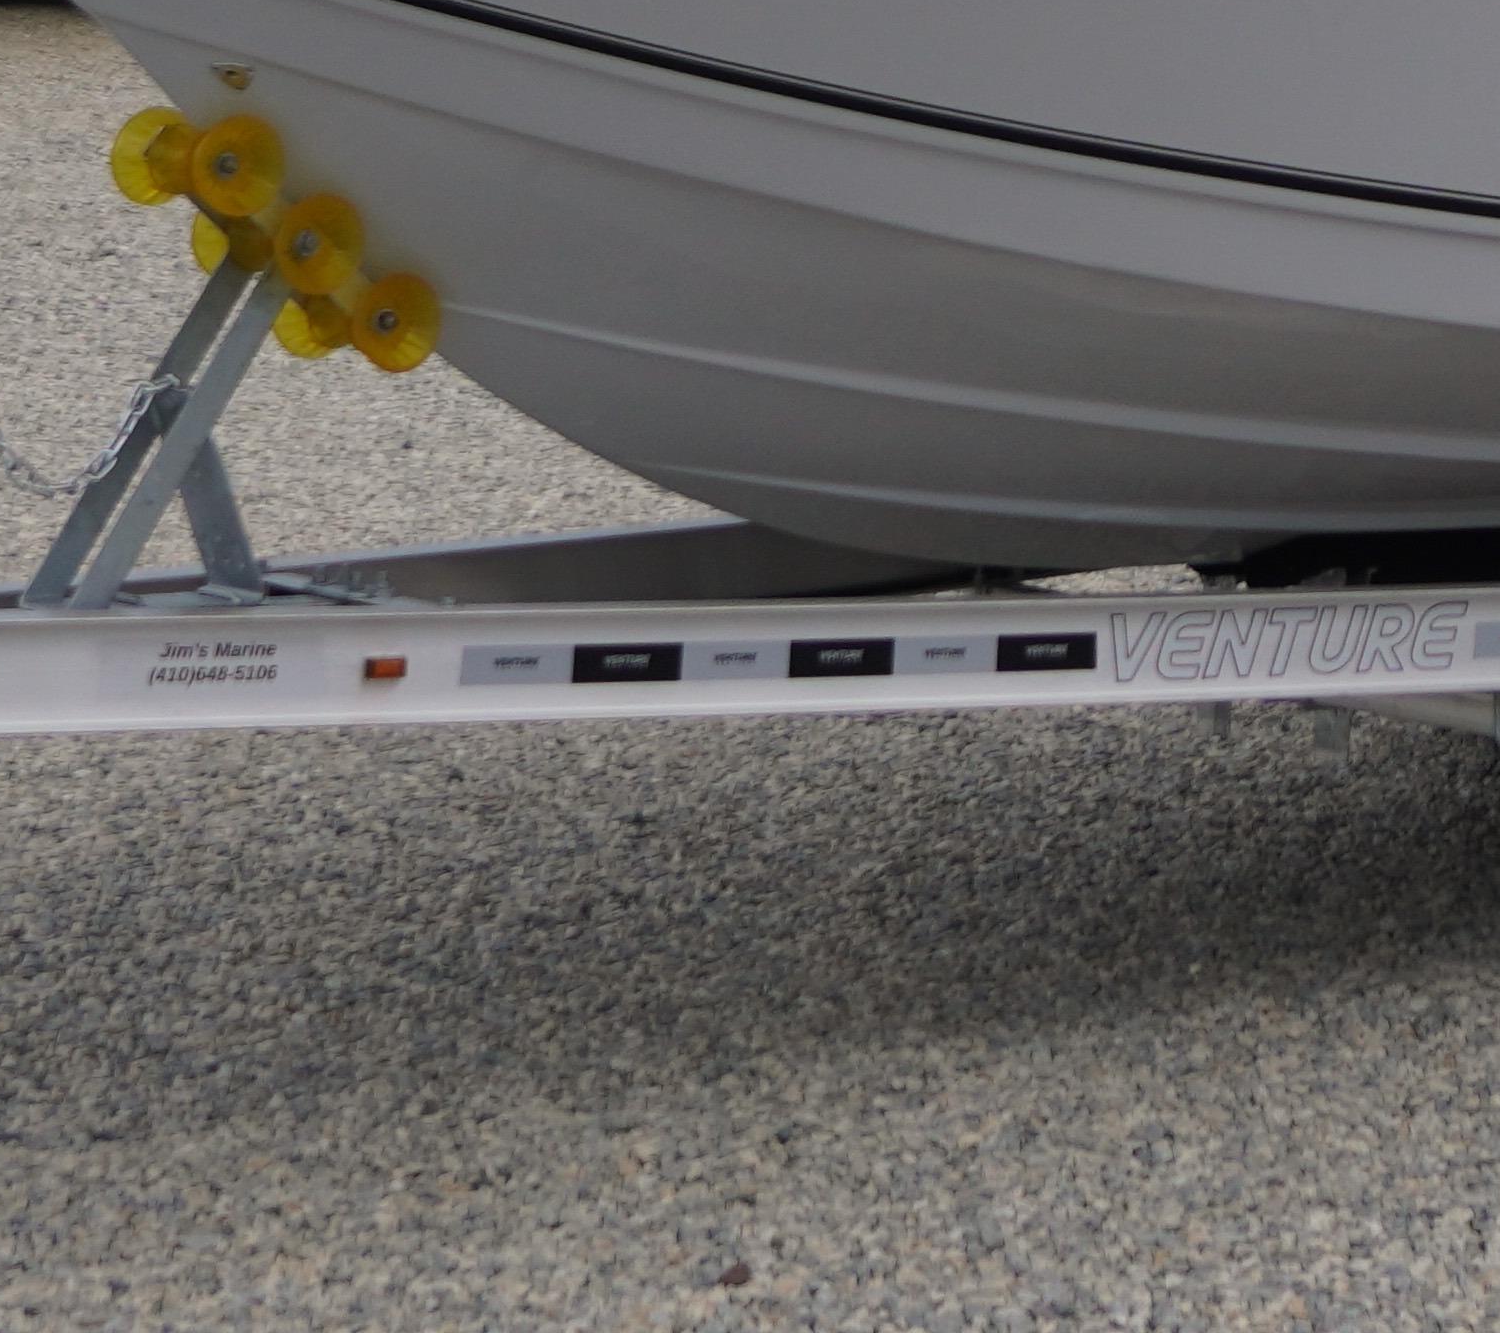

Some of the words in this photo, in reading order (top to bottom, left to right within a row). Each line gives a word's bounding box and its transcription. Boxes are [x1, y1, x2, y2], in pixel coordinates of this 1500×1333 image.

[158, 642, 210, 659] Jim's
[213, 641, 278, 658] Marine
[1110, 600, 1470, 683] VENTURE
